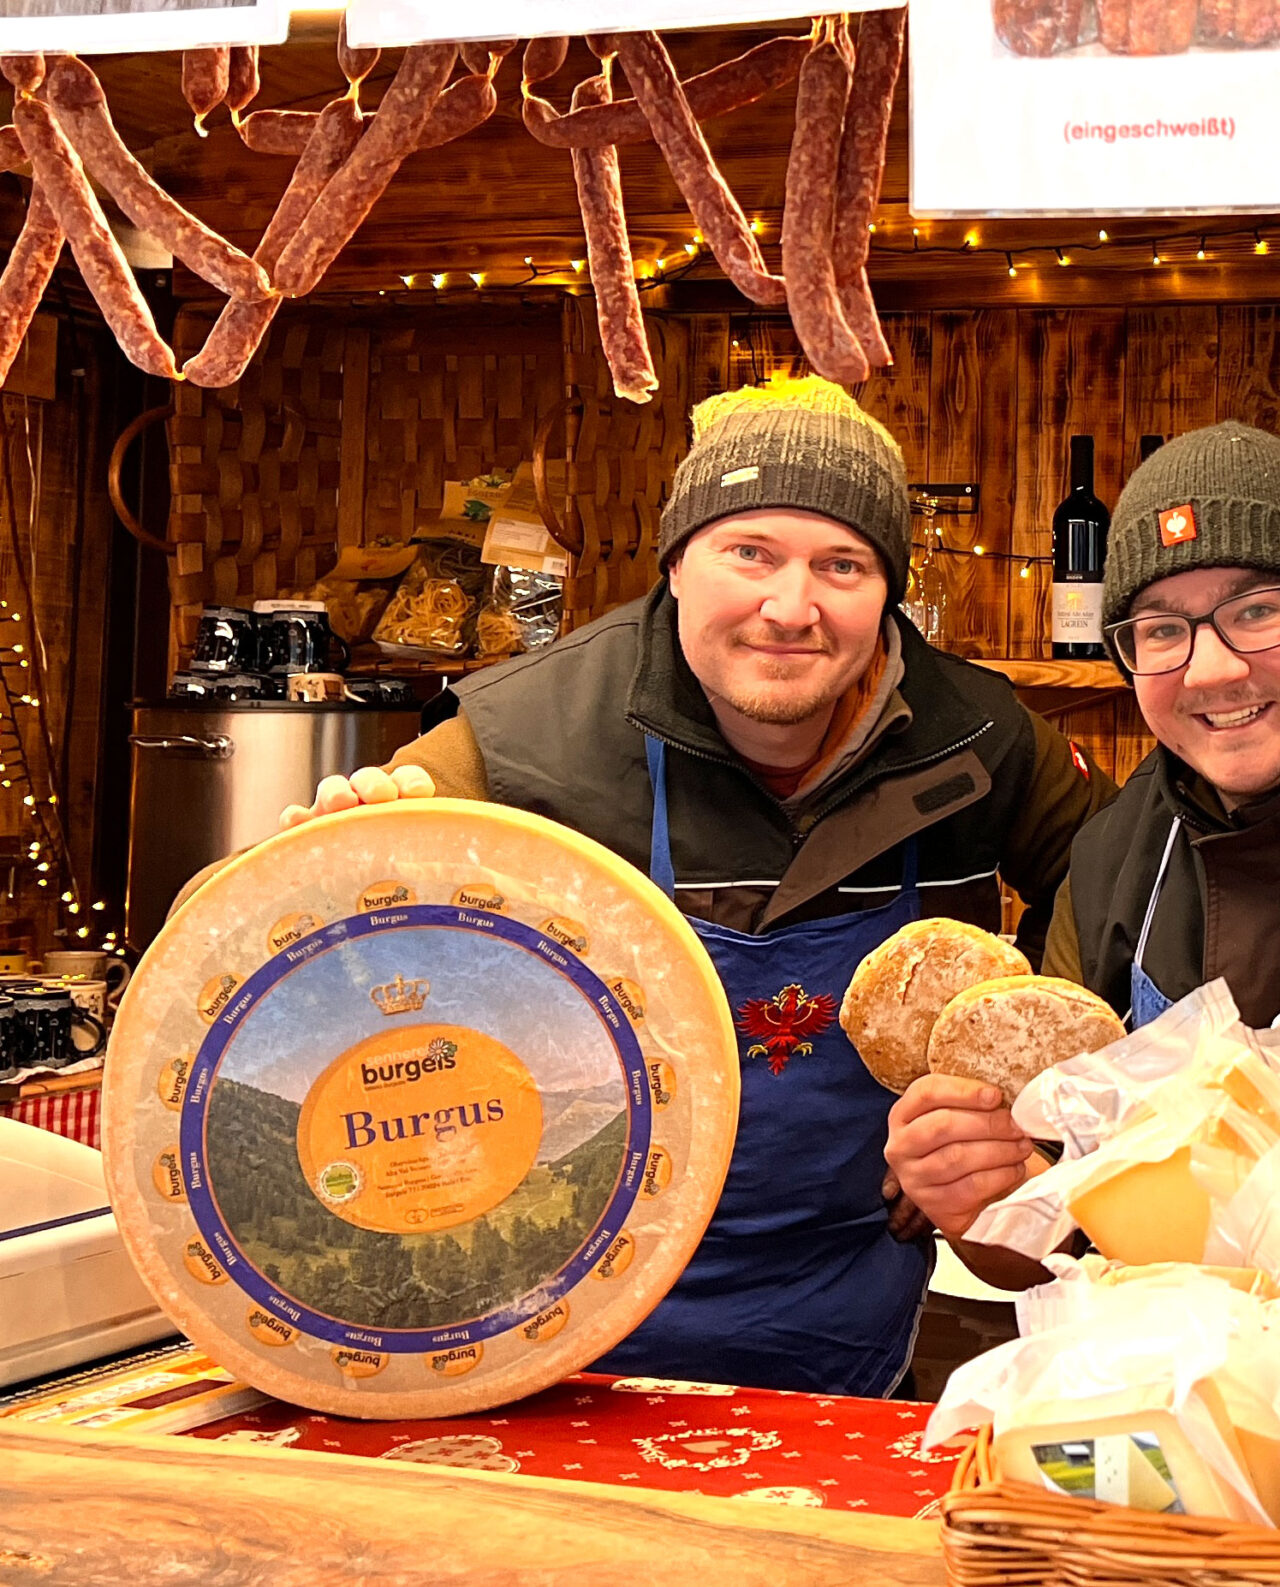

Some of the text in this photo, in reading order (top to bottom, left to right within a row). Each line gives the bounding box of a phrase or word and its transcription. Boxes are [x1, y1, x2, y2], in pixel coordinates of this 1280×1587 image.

[1063, 116, 1236, 145] (eingeschweißt)
[363, 893, 409, 908] burgeis
[370, 914, 409, 926] Burgus
[458, 912, 495, 928] Burgus
[286, 937, 324, 962] Burgus
[537, 939, 568, 966] Burgus
[223, 992, 253, 1024] Burgus
[598, 995, 620, 1029] Burgus
[361, 1056, 456, 1085] burgeis
[190, 1067, 208, 1104] Burgus
[631, 1069, 642, 1106] Burgus
[340, 1098, 504, 1151] Burgus
[190, 1151, 202, 1189] Burgus
[214, 1231, 237, 1266] Burgus
[583, 1229, 611, 1261] Burgus
[268, 1295, 301, 1322] Burgus
[345, 1331, 382, 1347] Burgus
[432, 1330, 469, 1343] Burgus
